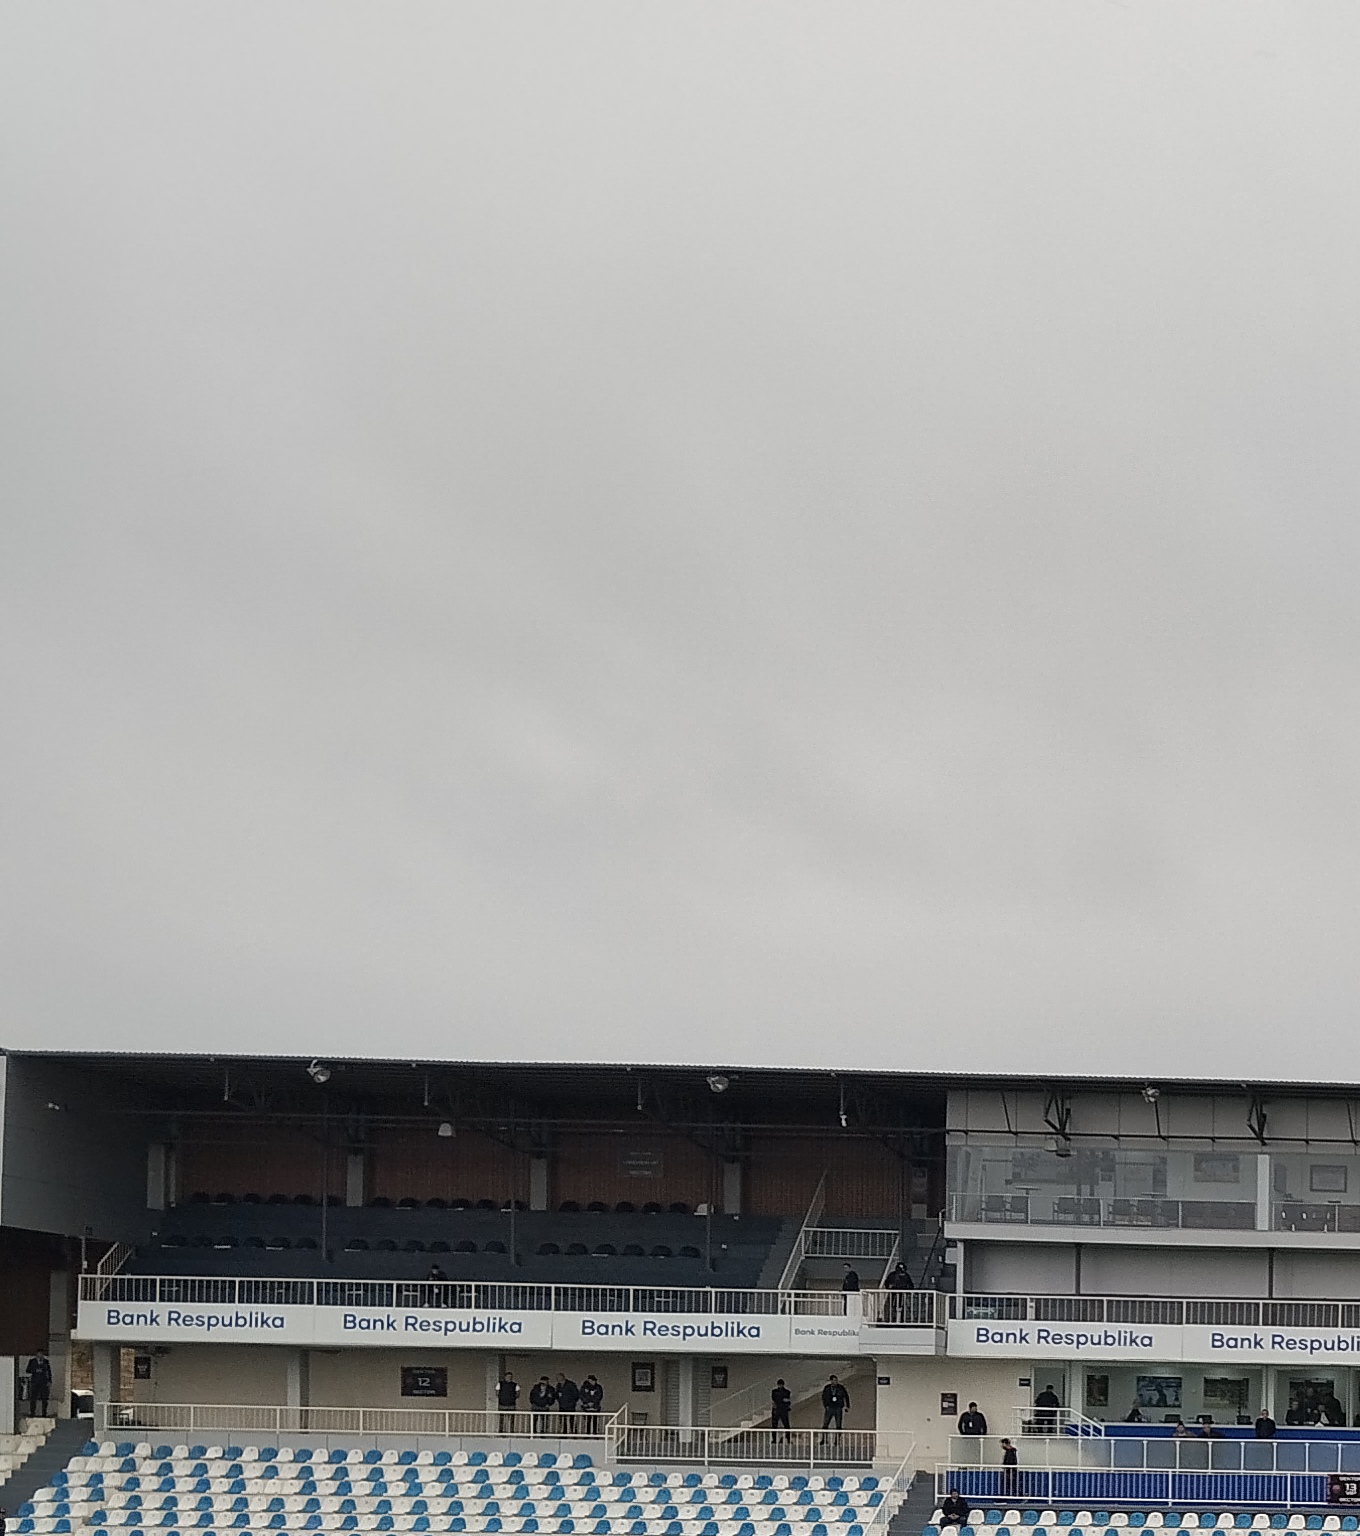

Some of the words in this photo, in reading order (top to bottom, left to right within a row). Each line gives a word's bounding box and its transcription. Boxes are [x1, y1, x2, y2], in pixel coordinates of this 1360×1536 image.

[106, 1308, 161, 1327] Bank
[167, 1310, 285, 1332] Respublika
[343, 1313, 398, 1332] Bank
[404, 1315, 523, 1337] Respublika
[581, 1319, 636, 1337] Bank
[642, 1320, 762, 1342] Respublika
[795, 1328, 816, 1336] Bank
[975, 1327, 1031, 1345] Bank
[1036, 1328, 1153, 1350] Respublika
[1211, 1332, 1265, 1350] Bank
[417, 1377, 431, 1387] 12
[1344, 1483, 1357, 1491] 13
